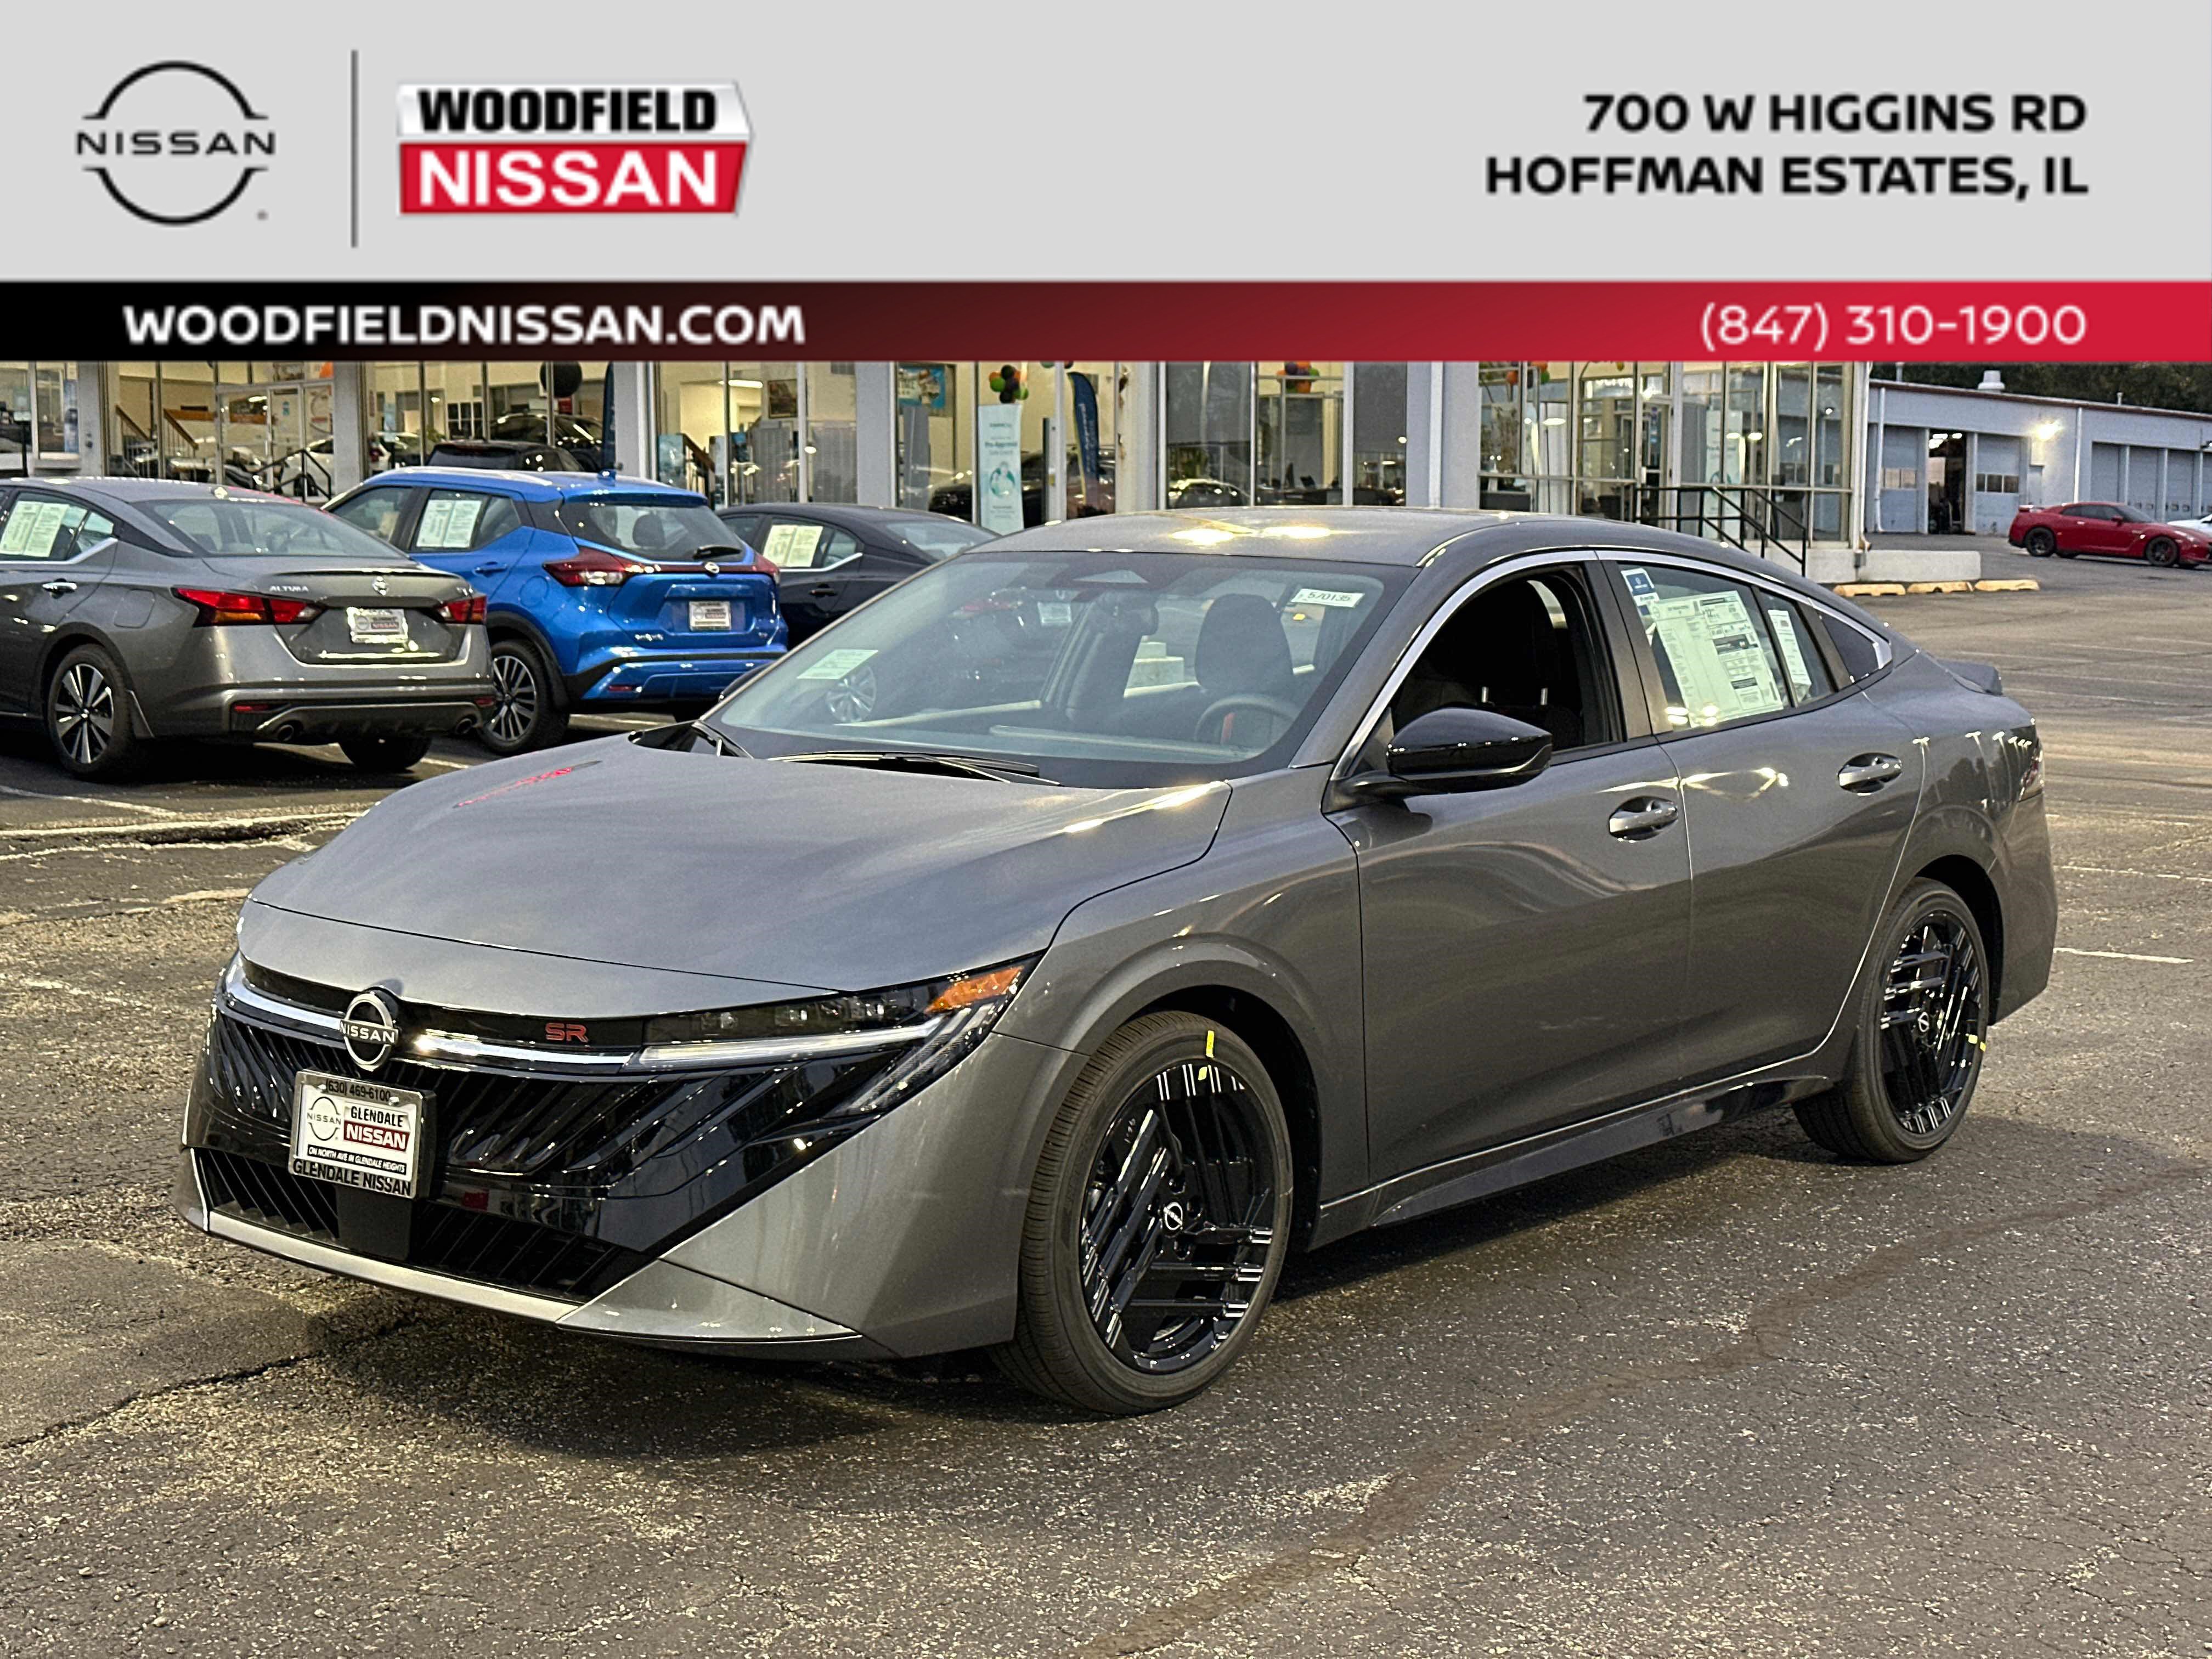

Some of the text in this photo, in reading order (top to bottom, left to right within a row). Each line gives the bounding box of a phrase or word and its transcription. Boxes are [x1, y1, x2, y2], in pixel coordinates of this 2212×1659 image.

[340, 1022, 395, 1043] NISSAN
[545, 1023, 589, 1042] SR
[326, 1079, 391, 1102] (630) 469-6100
[307, 1112, 341, 1125] NISSAN
[351, 1105, 404, 1127] GLENDALE
[346, 1124, 406, 1149] NISSAN
[308, 1147, 317, 1155] ON
[293, 1158, 411, 1197] GLENDALE NISSAN
